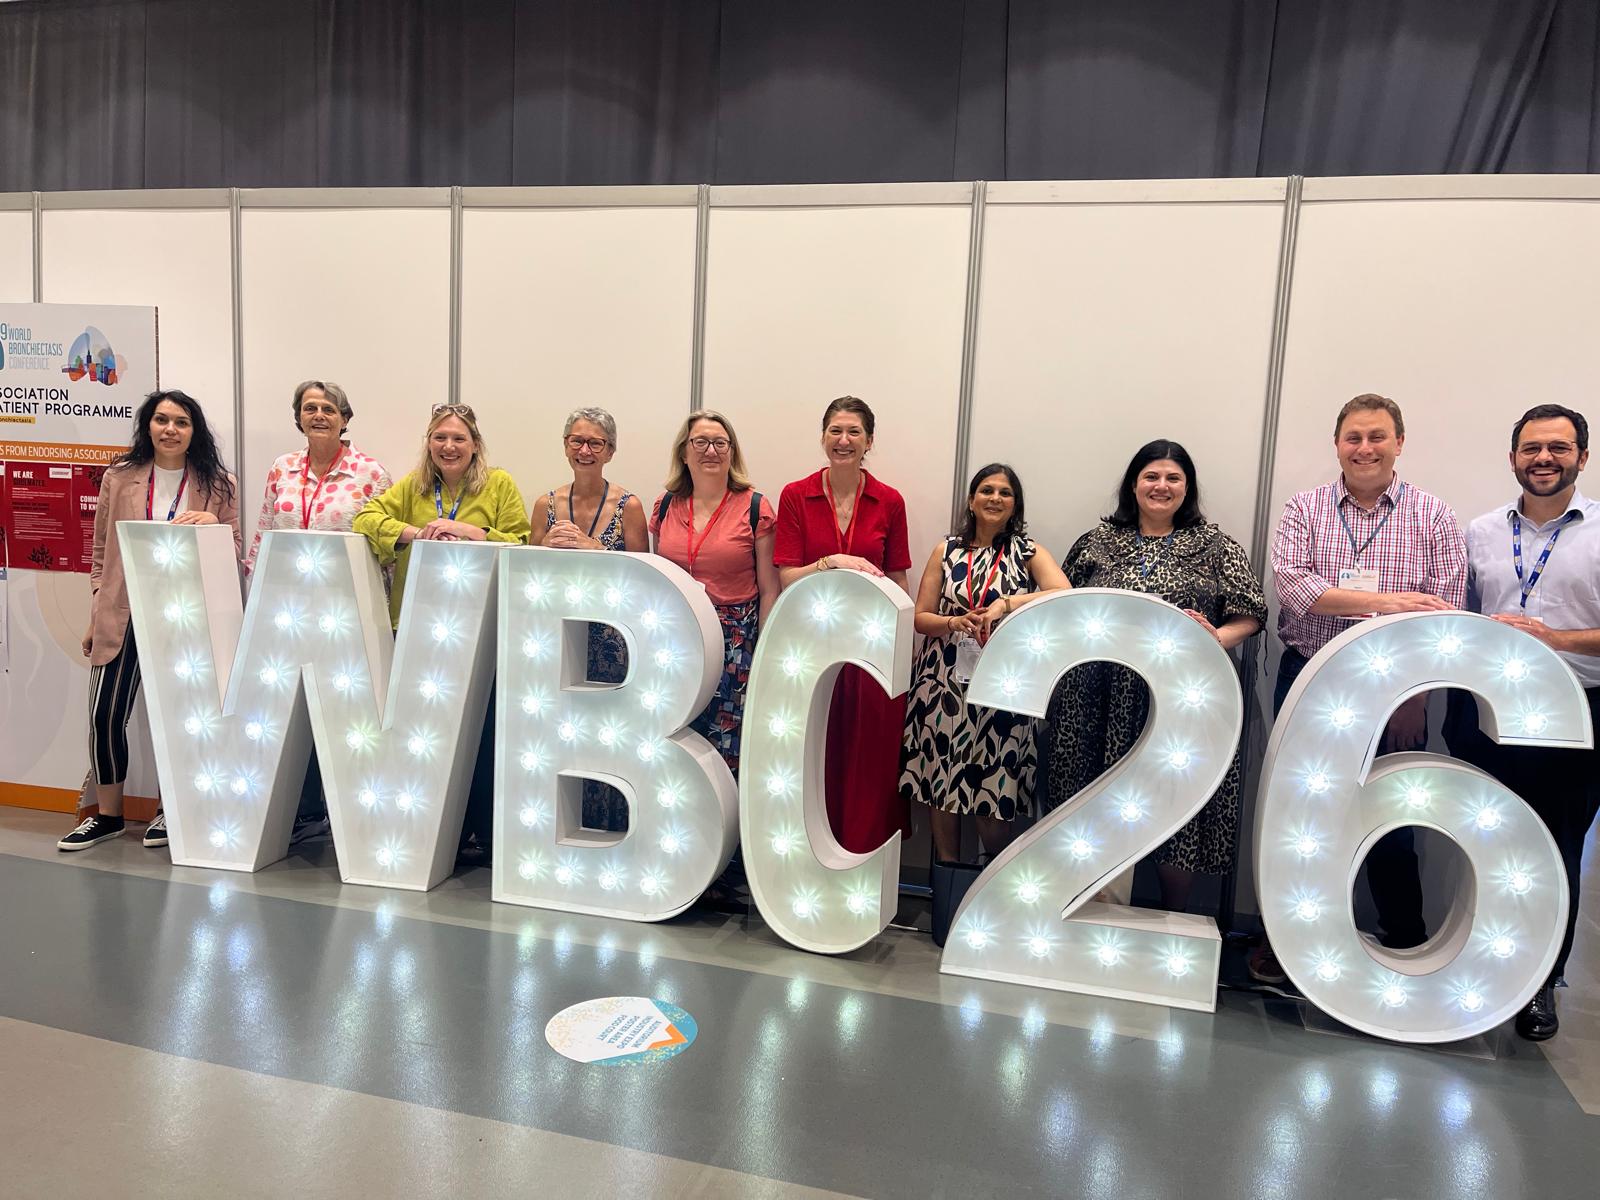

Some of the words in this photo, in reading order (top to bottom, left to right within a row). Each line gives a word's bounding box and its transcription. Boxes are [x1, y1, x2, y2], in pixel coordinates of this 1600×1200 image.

[8, 327, 32, 341] WORLD
[8, 342, 63, 356] BRONCHIECTASIS
[9, 356, 50, 370] CONFERENCE
[45, 403, 133, 418] PROGRAMME
[5, 445, 27, 457] FROM
[28, 446, 73, 459] ENDORSING
[73, 448, 129, 461] ASSOCIATIO
[12, 470, 21, 479] WE
[22, 471, 34, 479] ARE
[80, 495, 99, 503] COMM
[80, 503, 88, 511] TO
[617, 1035, 632, 1049] EXPO
